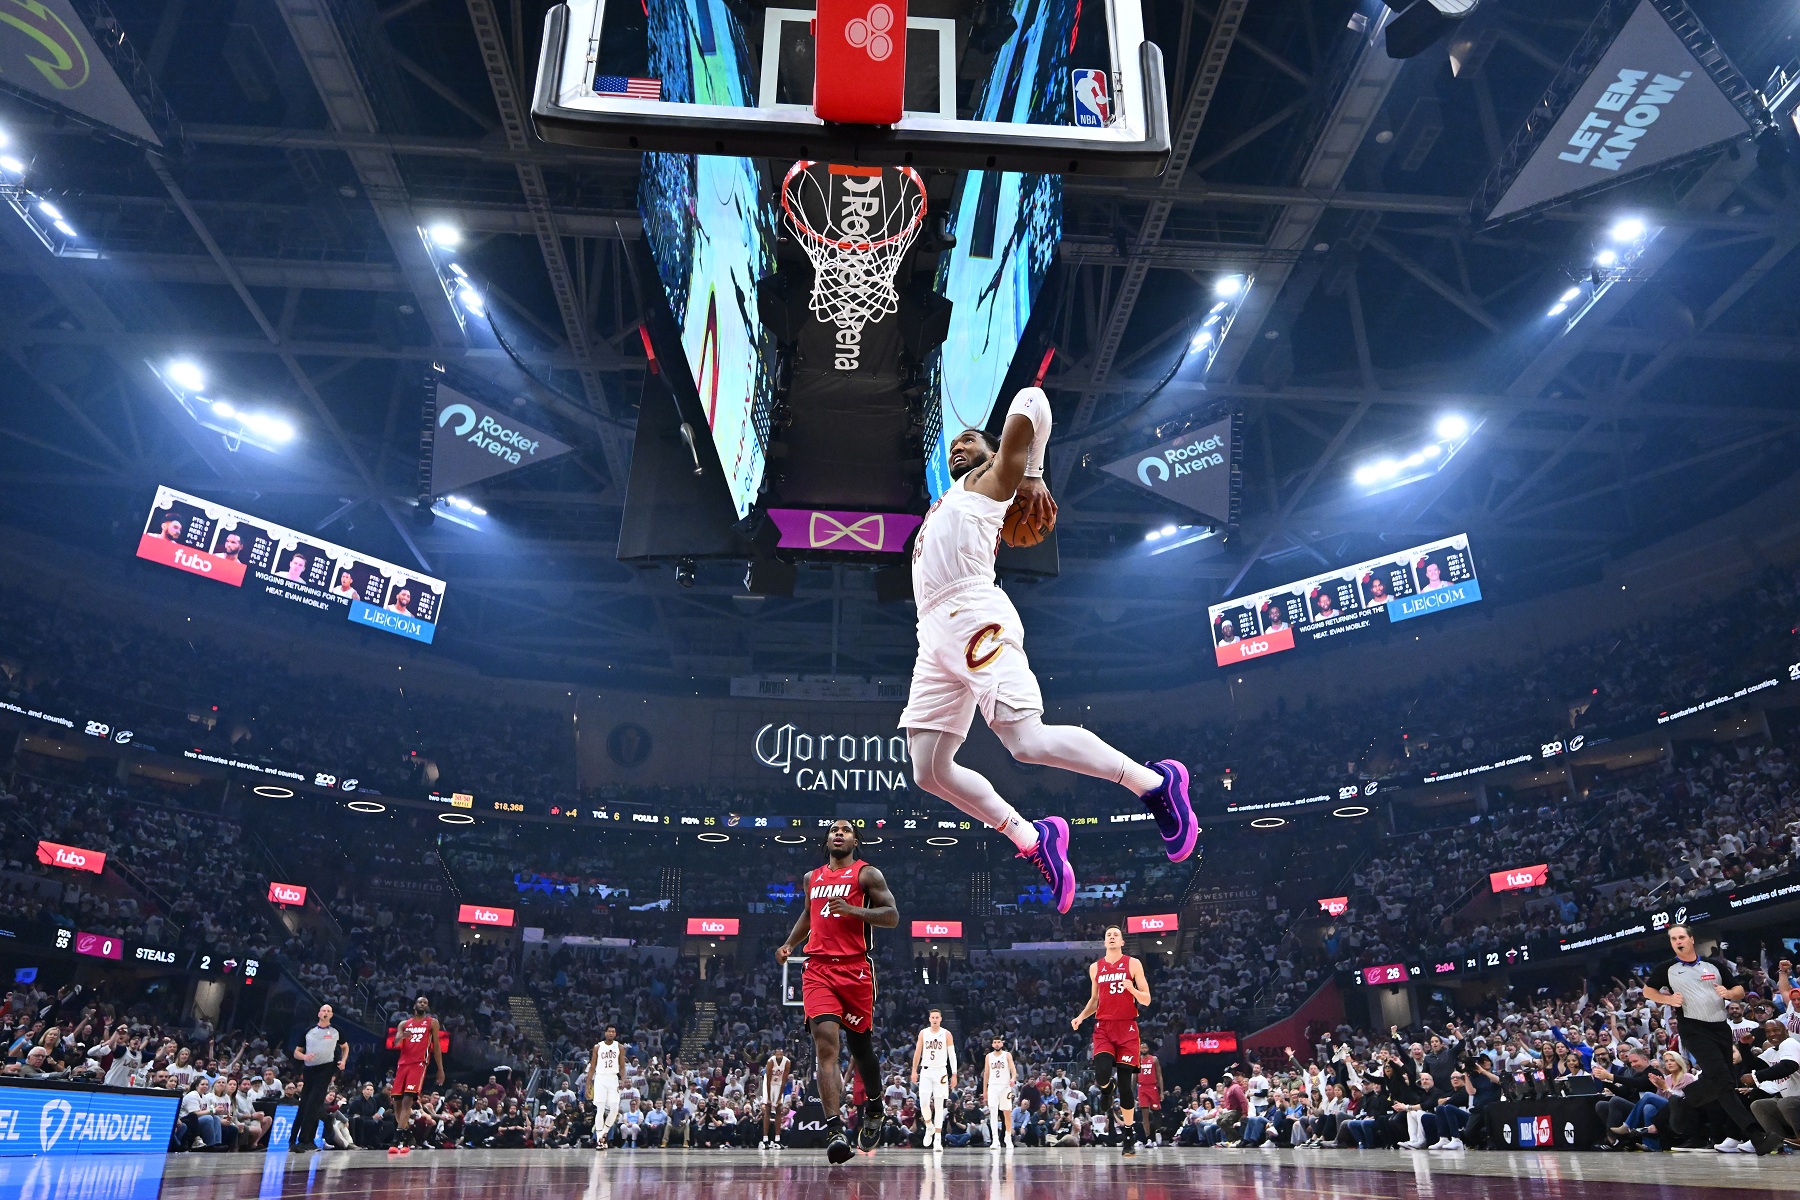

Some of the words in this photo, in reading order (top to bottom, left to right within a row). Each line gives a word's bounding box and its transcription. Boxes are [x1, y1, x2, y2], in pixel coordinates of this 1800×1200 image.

[1080, 114, 1098, 125] NBA
[1557, 111, 1612, 164] LET
[1594, 68, 1648, 112] EM
[1589, 70, 1693, 171] KNOW.
[478, 415, 540, 455] Rocket
[467, 430, 522, 465] Arena
[1164, 434, 1225, 464] Rocket
[1174, 452, 1224, 478] Arena
[174, 549, 212, 573] fubo
[255, 570, 285, 586] WIGGINS
[284, 579, 322, 598] RETURNING
[322, 591, 336, 602] FOR
[336, 596, 349, 607] THE
[284, 592, 302, 603] EVAN
[1299, 621, 1325, 634] WIGGINS
[1325, 611, 1358, 628] RETURNING
[1358, 608, 1372, 618] FOR
[1372, 606, 1385, 615] THE
[1329, 626, 1345, 636] EVAN
[1240, 641, 1269, 657] fubo
[1657, 716, 1670, 725] two
[1670, 706, 1698, 720] centuries
[1698, 702, 1705, 711] of
[1734, 688, 1747, 698] and
[28, 709, 42, 719] and
[751, 721, 909, 774] Corona
[184, 750, 198, 759] two
[198, 754, 228, 766] centuries
[228, 759, 236, 767] of
[264, 766, 278, 775] and
[1424, 776, 1436, 784] two
[1436, 771, 1462, 782] centuries
[1462, 769, 1469, 777] of
[1494, 760, 1506, 769] and
[796, 767, 910, 791] CANTINA
[428, 794, 440, 802] two
[494, 802, 524, 812] $18,368
[1238, 802, 1264, 812] centuries
[1294, 798, 1306, 806] and
[592, 810, 609, 820] TOL
[613, 812, 620, 822] 6
[632, 813, 659, 824] FOULS
[664, 816, 670, 825] 3
[704, 818, 716, 826] 55
[754, 818, 768, 826] 26
[904, 820, 917, 829] 22
[959, 822, 970, 830] 50
[56, 848, 86, 866] fubo
[1506, 872, 1533, 887] fubo
[274, 886, 301, 902] fubo
[810, 884, 852, 900] MIAMI
[1730, 898, 1742, 909] two
[1742, 894, 1771, 906] centuries
[1771, 891, 1778, 899] of
[474, 909, 499, 922] fubo
[1652, 912, 1670, 926] 200
[702, 921, 725, 933] fubo
[926, 923, 948, 936] fubo
[1141, 918, 1164, 930] fubo
[57, 928, 72, 940] FG%
[55, 938, 69, 950] 55
[1560, 942, 1570, 952] two
[1570, 937, 1592, 950] centuries
[1592, 936, 1597, 945] of
[1616, 930, 1624, 938] and
[102, 940, 112, 956] 0
[135, 947, 176, 964] STEALS
[1486, 952, 1500, 966] 22
[1522, 952, 1529, 961] 2
[200, 956, 211, 970] 2
[246, 959, 260, 968] FG%
[1435, 962, 1455, 974] 2:04
[1467, 958, 1476, 968] 21
[244, 966, 258, 978] 50
[1386, 966, 1400, 980] 26
[1410, 966, 1421, 976] 1Q
[1098, 972, 1127, 984] MIAMI
[1355, 976, 1362, 986] 3
[1109, 982, 1125, 995] 55
[410, 1034, 424, 1043] 22
[1196, 1036, 1220, 1050] fubo
[930, 1051, 936, 1061] 5
[604, 1060, 613, 1069] 12
[996, 1070, 1000, 1078] 2
[1143, 1068, 1152, 1076] 24
[69, 1112, 152, 1141] FANDUEL
